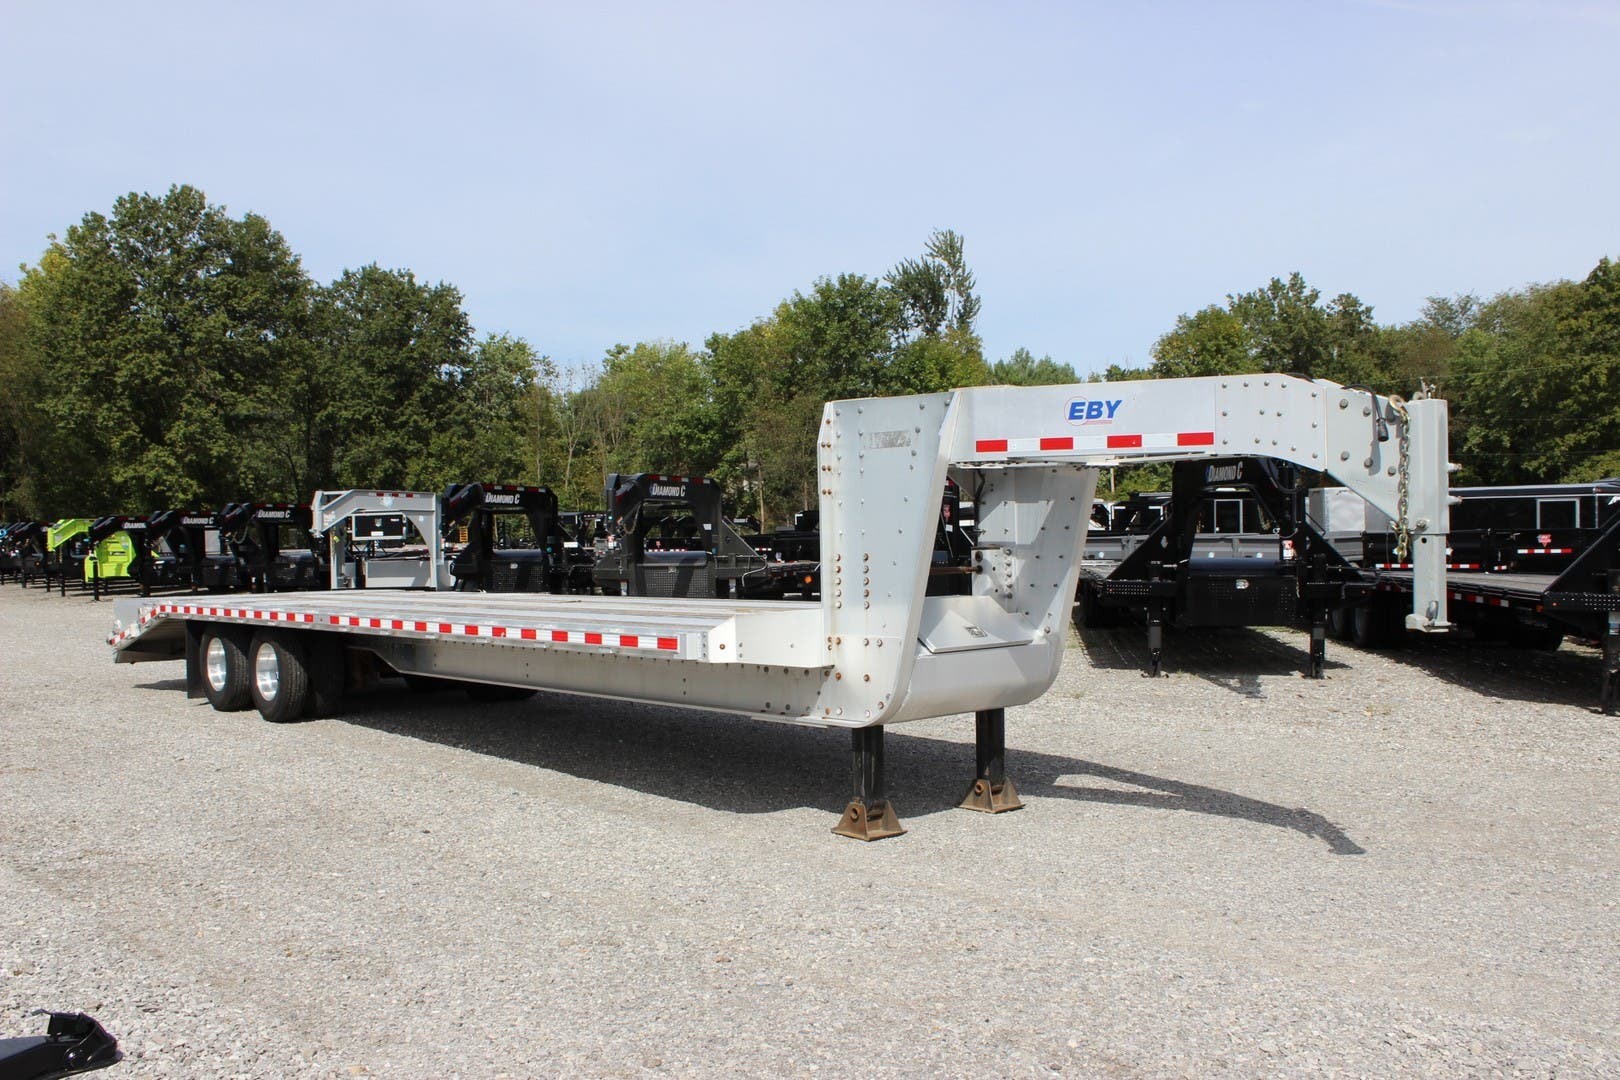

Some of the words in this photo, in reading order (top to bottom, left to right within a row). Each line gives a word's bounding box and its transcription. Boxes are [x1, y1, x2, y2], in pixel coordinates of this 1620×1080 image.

[1068, 399, 1123, 420] EBY
[1208, 464, 1237, 483] DIAMOND
[1237, 461, 1243, 480] C
[652, 483, 680, 497] DIAMOND
[680, 484, 686, 497] C
[484, 492, 514, 504] DIAMOND
[514, 494, 520, 505] C
[257, 509, 285, 518] DIAMOND
[285, 510, 291, 518] C
[123, 521, 147, 529] DIAMON
[182, 516, 209, 525] DIAMOND
[209, 517, 215, 525] C
